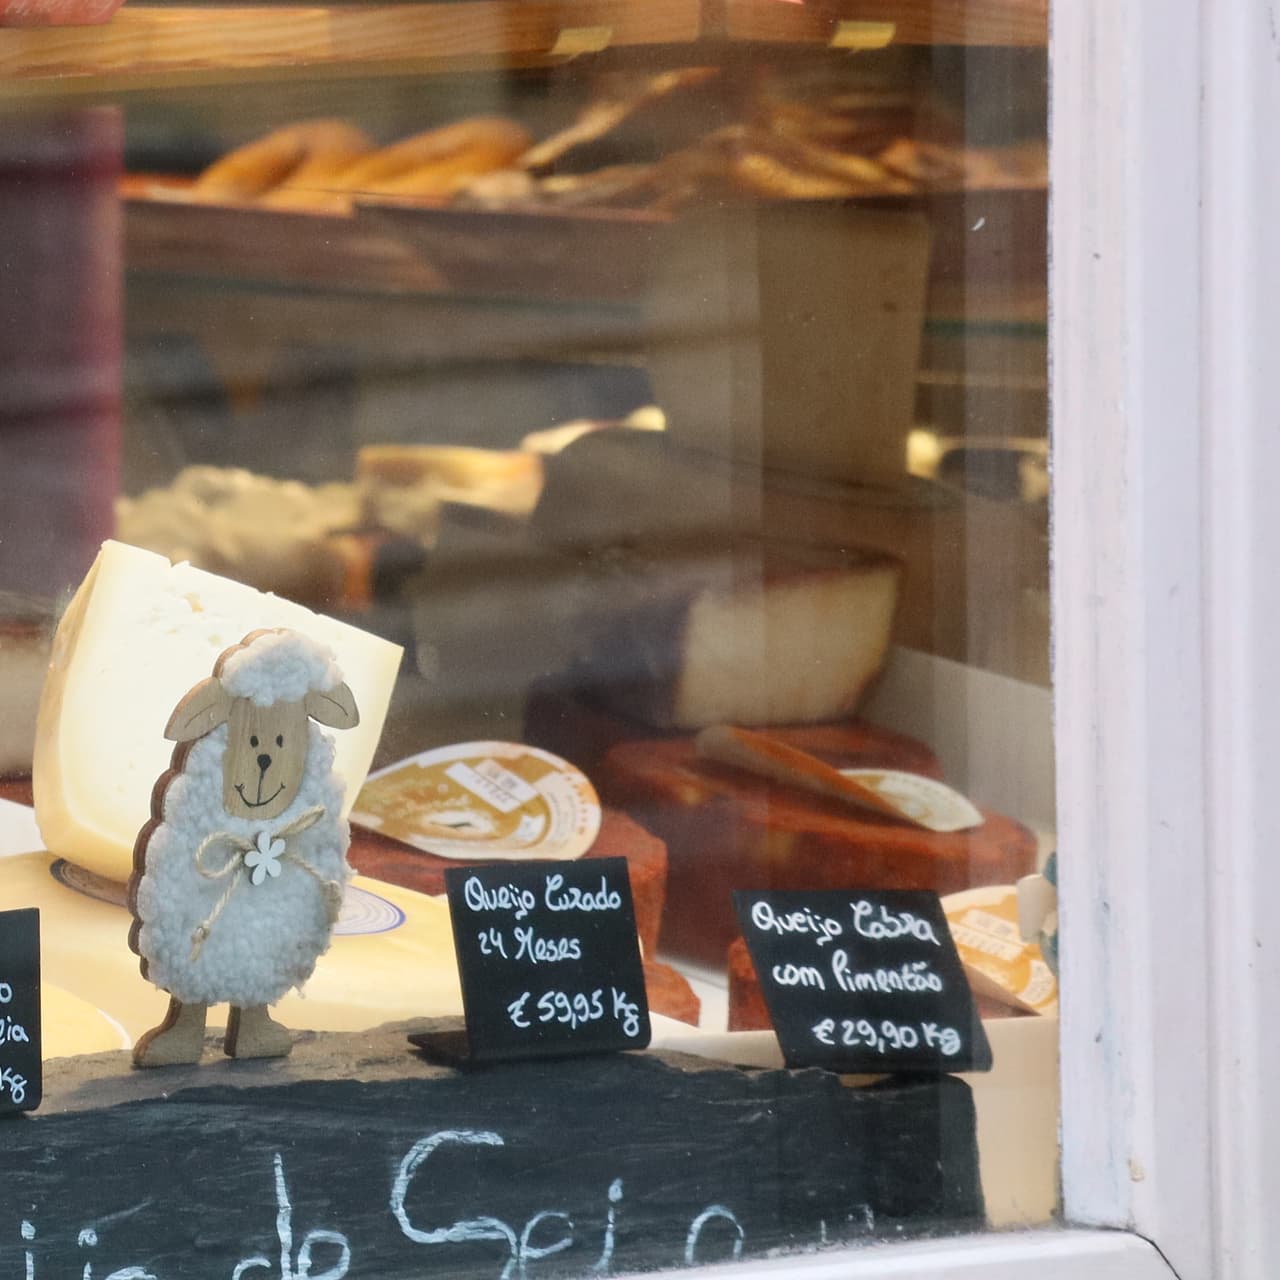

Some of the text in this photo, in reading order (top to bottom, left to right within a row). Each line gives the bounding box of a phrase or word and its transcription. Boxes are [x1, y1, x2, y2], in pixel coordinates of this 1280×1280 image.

[464, 873, 622, 920] Queijo Curado
[478, 926, 582, 965] 24 Meses
[751, 899, 942, 947] Queijo Cabra
[772, 948, 944, 994] com Pimentão
